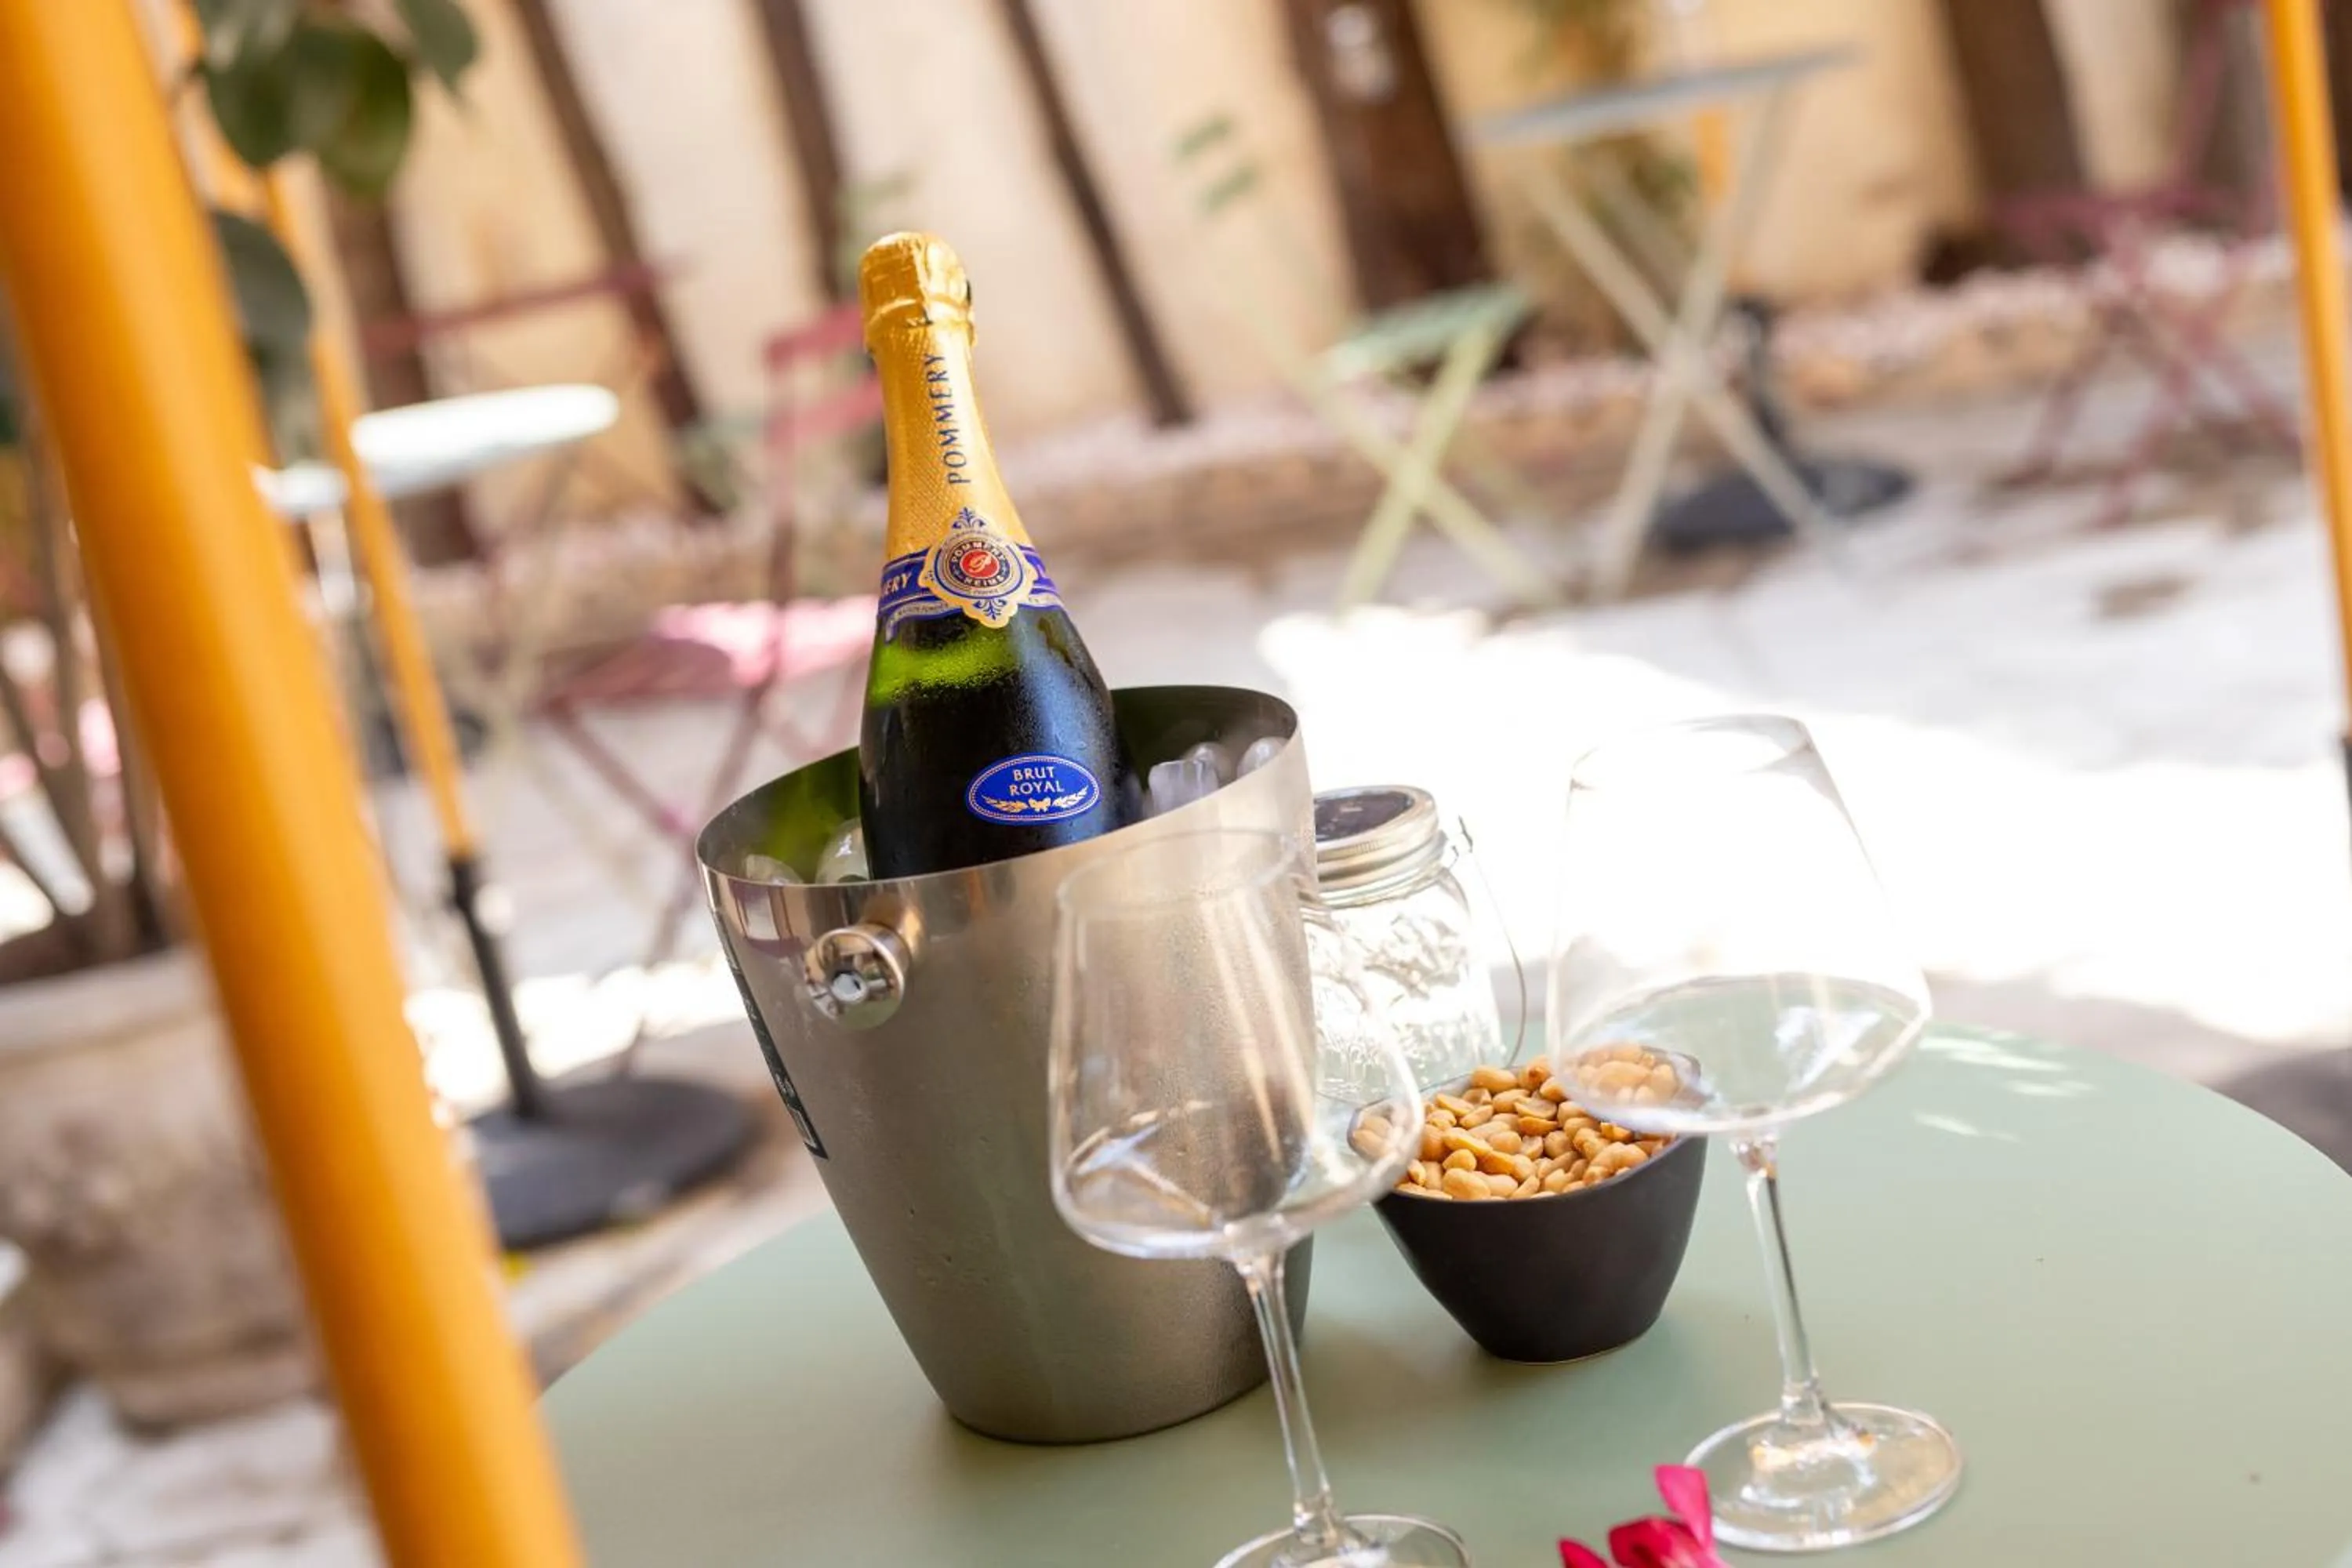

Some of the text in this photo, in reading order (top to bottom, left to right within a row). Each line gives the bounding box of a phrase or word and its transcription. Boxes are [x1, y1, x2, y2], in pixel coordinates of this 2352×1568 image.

[924, 353, 971, 485] POMMERY
[1012, 766, 1055, 782] BRUT
[1009, 780, 1065, 797] ROYAL
